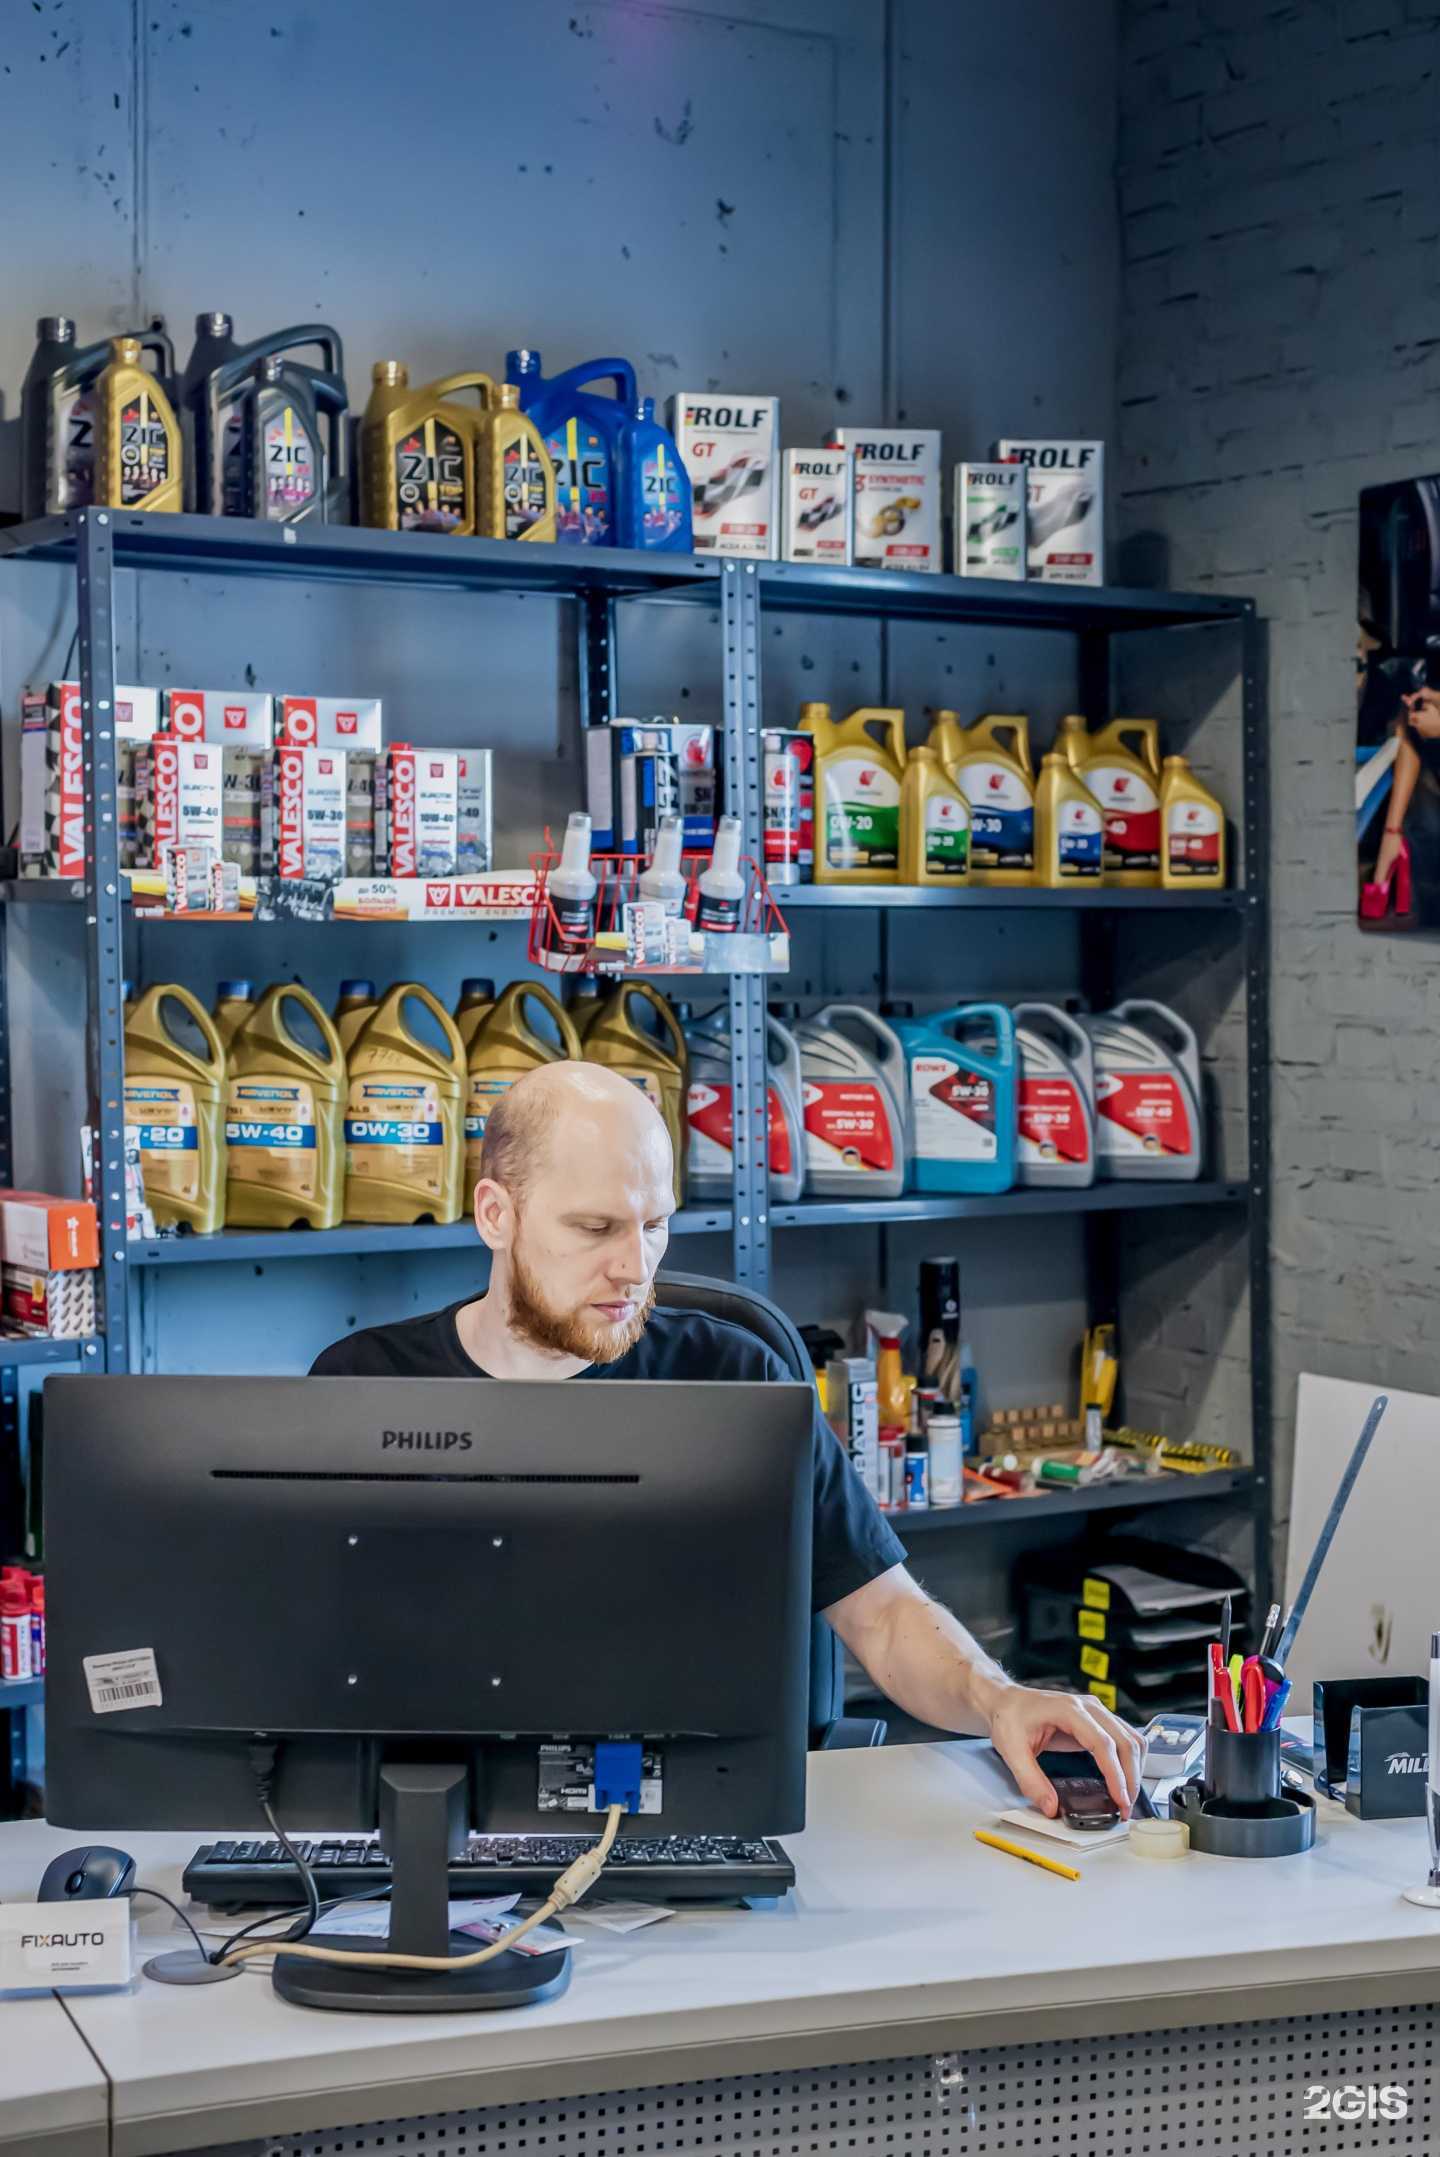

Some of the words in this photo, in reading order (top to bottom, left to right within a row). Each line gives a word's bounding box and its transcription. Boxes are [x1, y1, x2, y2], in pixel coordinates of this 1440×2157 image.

[694, 407, 768, 428] ROLF
[124, 426, 166, 445] ZIC
[269, 445, 306, 464] ZIC
[692, 442, 717, 458] GT
[862, 443, 925, 461] ROLF
[1018, 448, 1096, 469] ROLF
[399, 453, 463, 485] ZIC
[504, 463, 545, 485] ZIC
[799, 462, 846, 476] ROLF
[645, 476, 675, 494] ZIC
[970, 472, 1019, 486] ROLF
[799, 488, 818, 500] GT
[157, 751, 178, 858] ALESCO
[282, 756, 304, 876] VALESCO
[307, 809, 344, 821] 5W-30
[395, 760, 416, 877] VALESCO
[372, 884, 398, 895] 50%
[226, 1123, 304, 1141] 5W-40
[351, 1121, 430, 1138] 0W-30
[382, 1430, 473, 1450] PHILIPS
[21, 1932, 104, 1948] FIXAUTO
